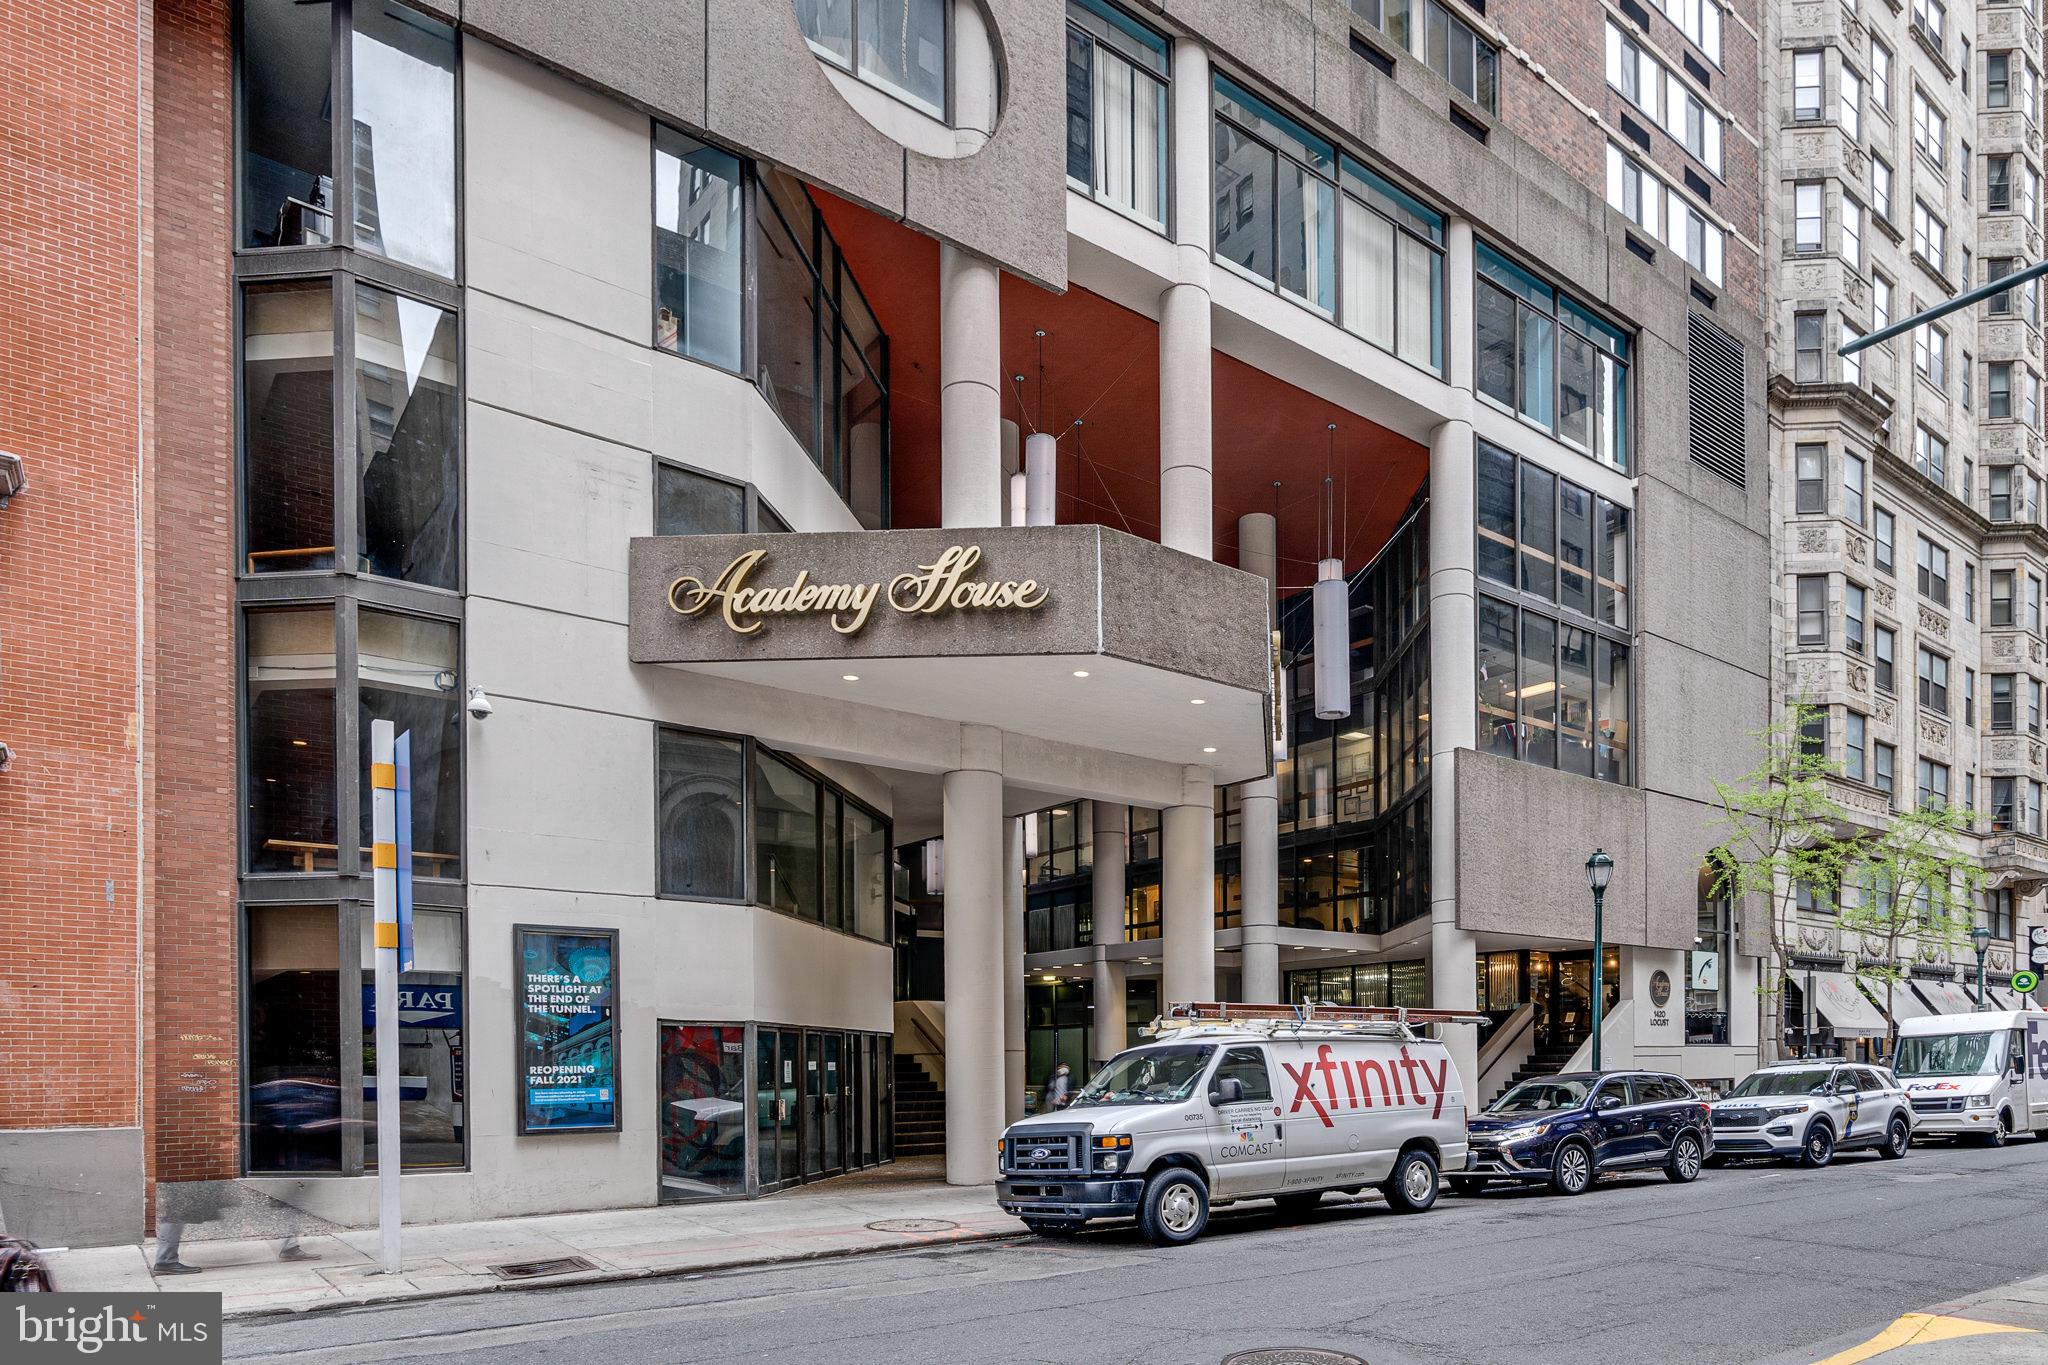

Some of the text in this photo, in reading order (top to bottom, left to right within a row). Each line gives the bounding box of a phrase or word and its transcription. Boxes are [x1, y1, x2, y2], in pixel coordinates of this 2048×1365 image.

[668, 545, 1049, 634] Academy House
[527, 974, 581, 984] THERE'S A
[528, 984, 602, 994] SPOTLIGHT AT
[528, 994, 590, 1004] THE END OF
[528, 1004, 596, 1014] THE TUNNEL.
[1653, 1010, 1666, 1018] 1420
[530, 1065, 595, 1074] REOPENING
[530, 1075, 582, 1085] FALL 2021
[1282, 1044, 1447, 1128] xfinity
[1907, 1082, 1960, 1092] FedEx
[1184, 1114, 1204, 1122] 00735
[1221, 1142, 1273, 1158] COMCAST
